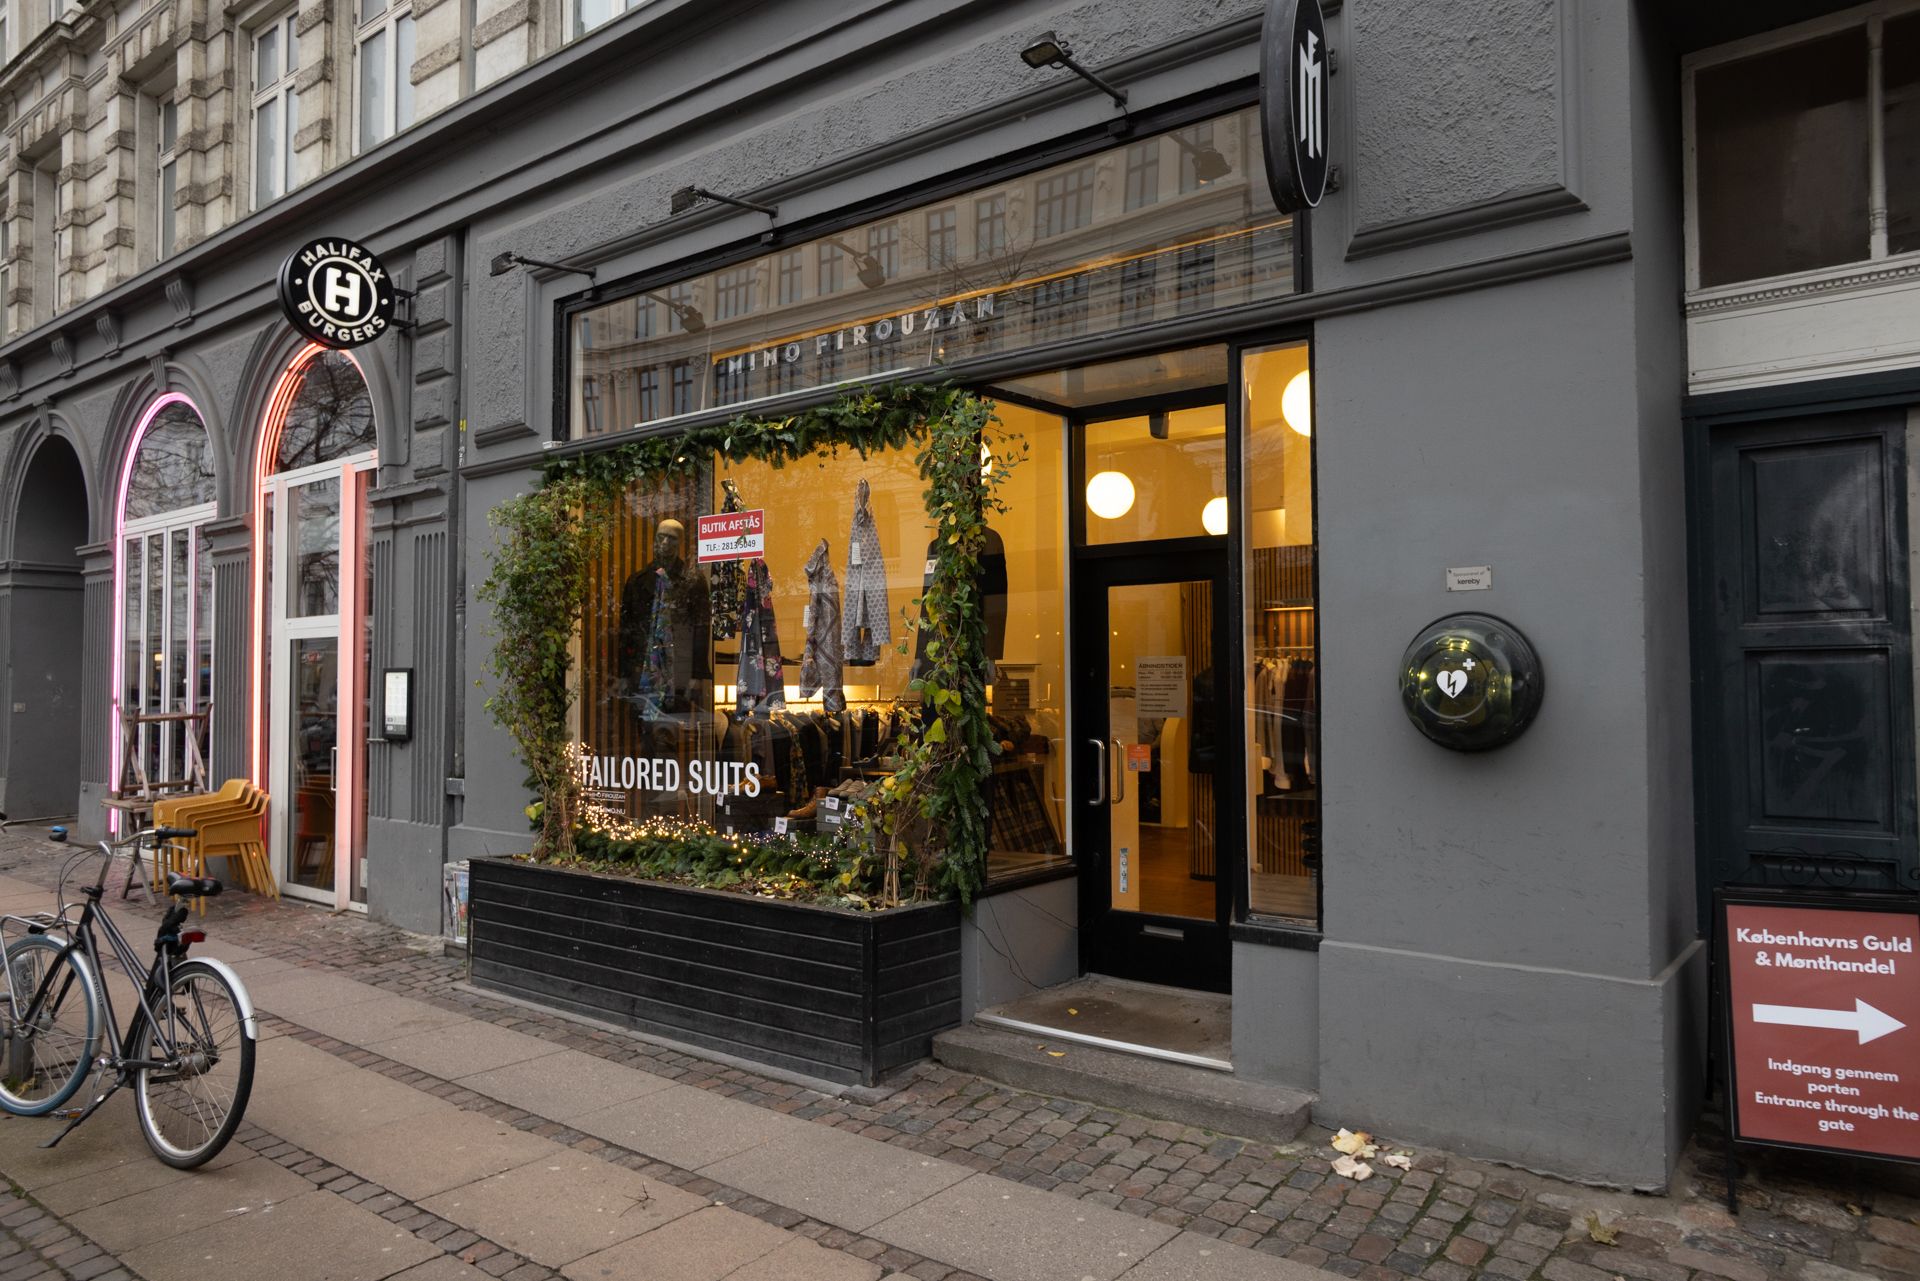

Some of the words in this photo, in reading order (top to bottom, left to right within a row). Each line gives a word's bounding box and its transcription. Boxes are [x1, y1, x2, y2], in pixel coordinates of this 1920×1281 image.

[301, 242, 385, 283] HALIFAX
[325, 267, 361, 317] H
[298, 300, 385, 342] BURGERS
[728, 342, 800, 376] MIMO
[816, 293, 994, 355] FIROUZAN
[701, 521, 727, 534] BUTIK
[729, 515, 760, 531] AFSTÅS
[722, 541, 737, 551] 2813
[579, 755, 680, 792] TAILORED
[688, 759, 761, 798] SUITS
[1736, 927, 1859, 950] Københavns
[1863, 934, 1913, 954] Guld
[1755, 951, 1772, 967] &
[1775, 951, 1896, 975] Mønthandel
[1768, 1057, 1832, 1079] Indgang
[1835, 1067, 1899, 1083] gennem
[1808, 1081, 1860, 1097] porten
[1755, 1091, 1821, 1110] Entrance
[1824, 1098, 1889, 1120] through
[1892, 1106, 1920, 1121] the
[1818, 1117, 1855, 1132] gate
